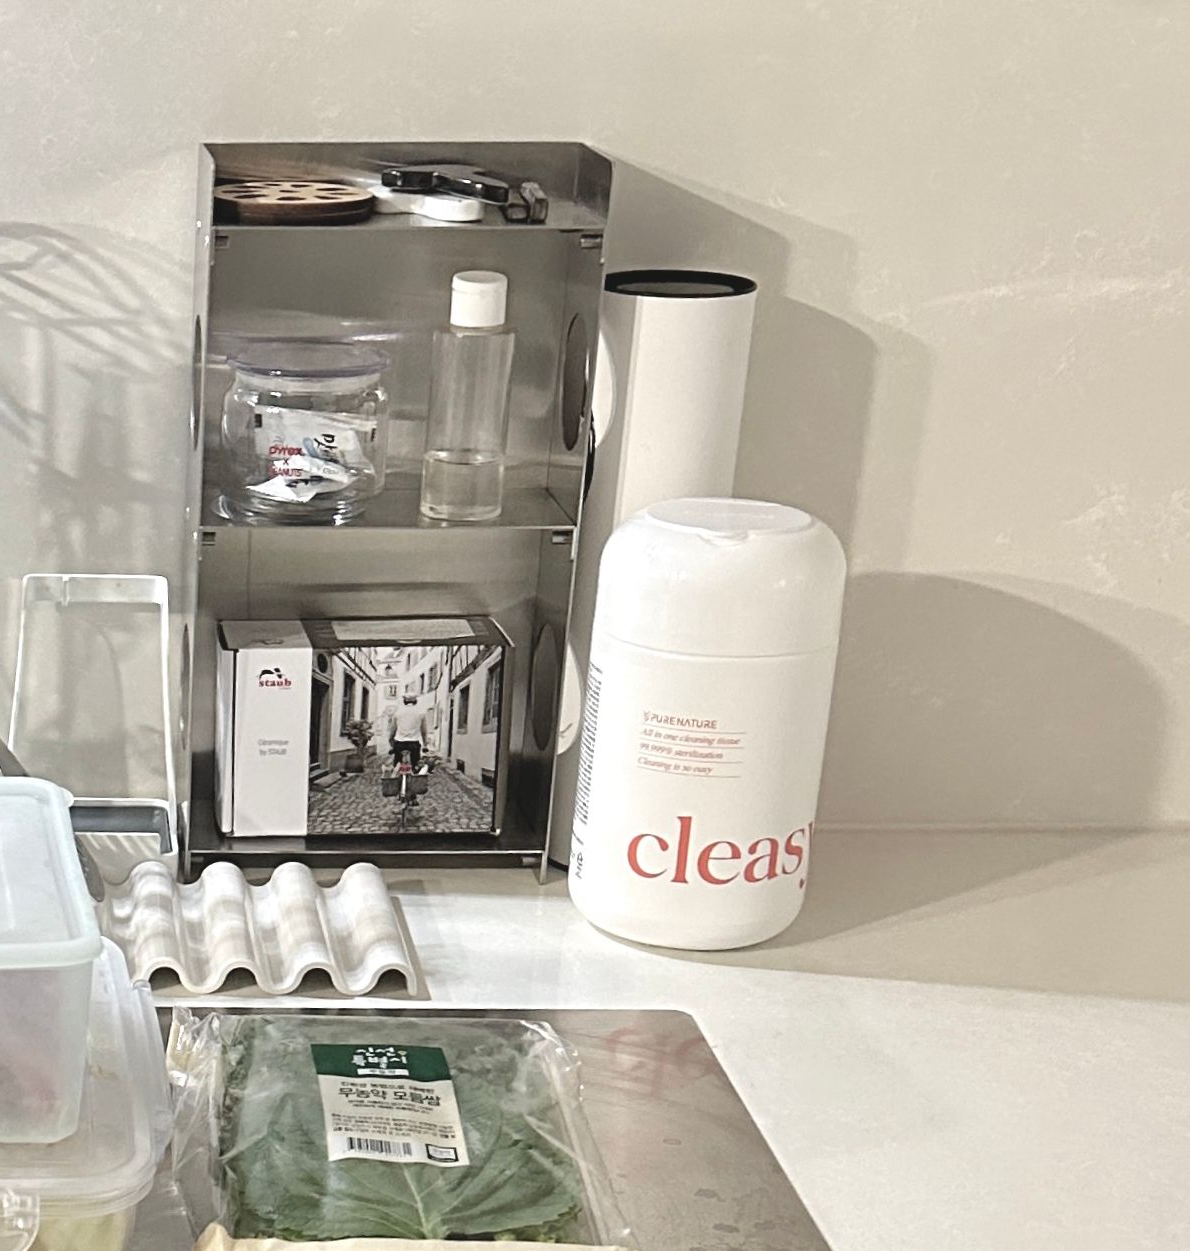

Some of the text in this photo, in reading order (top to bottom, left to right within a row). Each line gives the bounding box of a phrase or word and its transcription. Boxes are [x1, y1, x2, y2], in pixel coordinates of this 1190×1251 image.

[269, 446, 303, 456] pyrex
[259, 678, 292, 687] staub
[654, 730, 662, 738] in
[679, 734, 715, 746] cleaning
[637, 756, 671, 771] Cleaning
[693, 766, 713, 777] easy
[338, 1087, 387, 1100] 무농약
